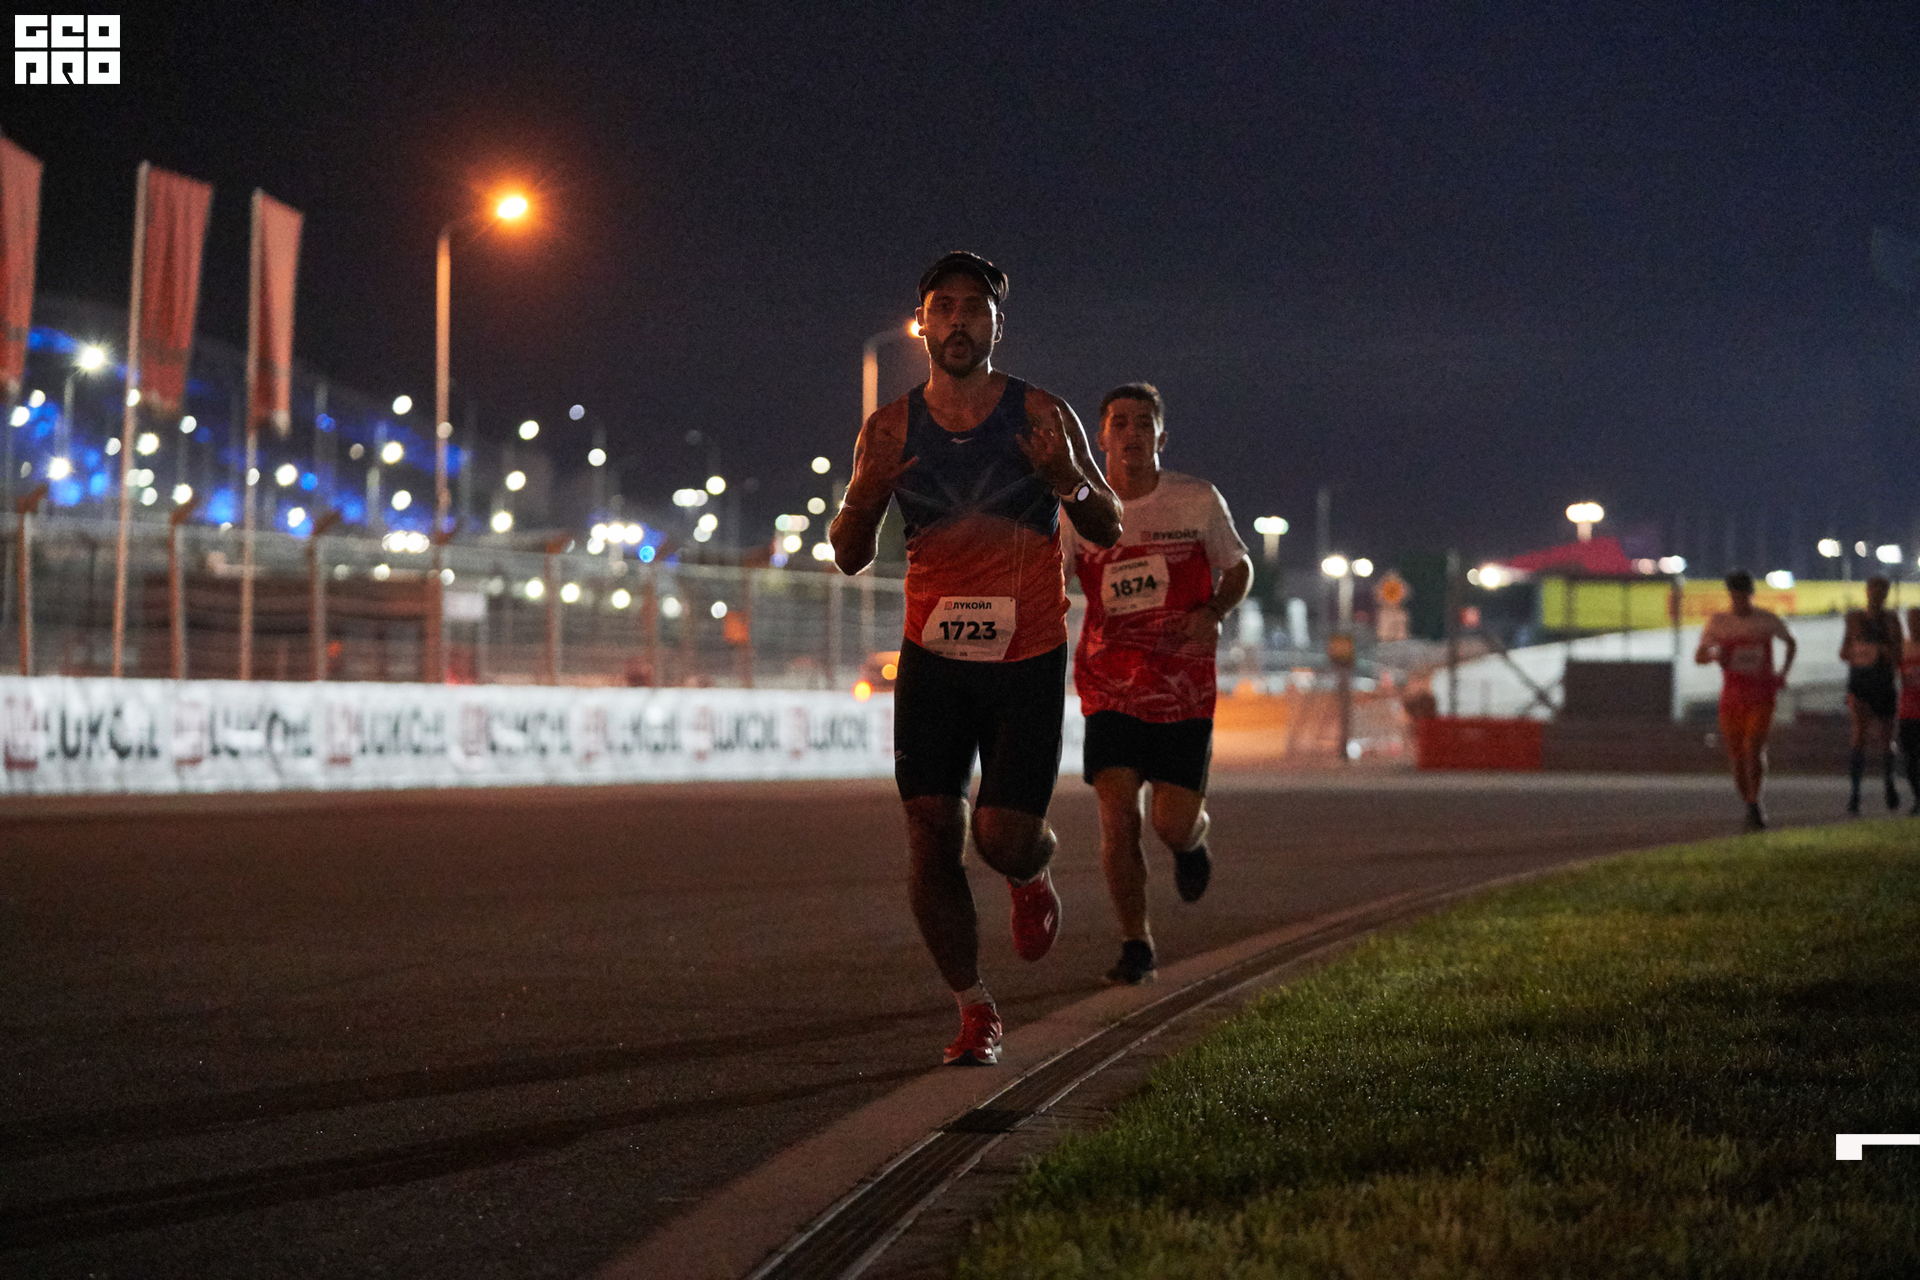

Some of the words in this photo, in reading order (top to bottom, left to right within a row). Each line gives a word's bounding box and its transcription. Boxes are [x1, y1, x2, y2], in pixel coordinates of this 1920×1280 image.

[1111, 574, 1157, 598] 1874
[952, 600, 992, 610] ЛУКОЙЛ
[939, 621, 997, 640] 1723
